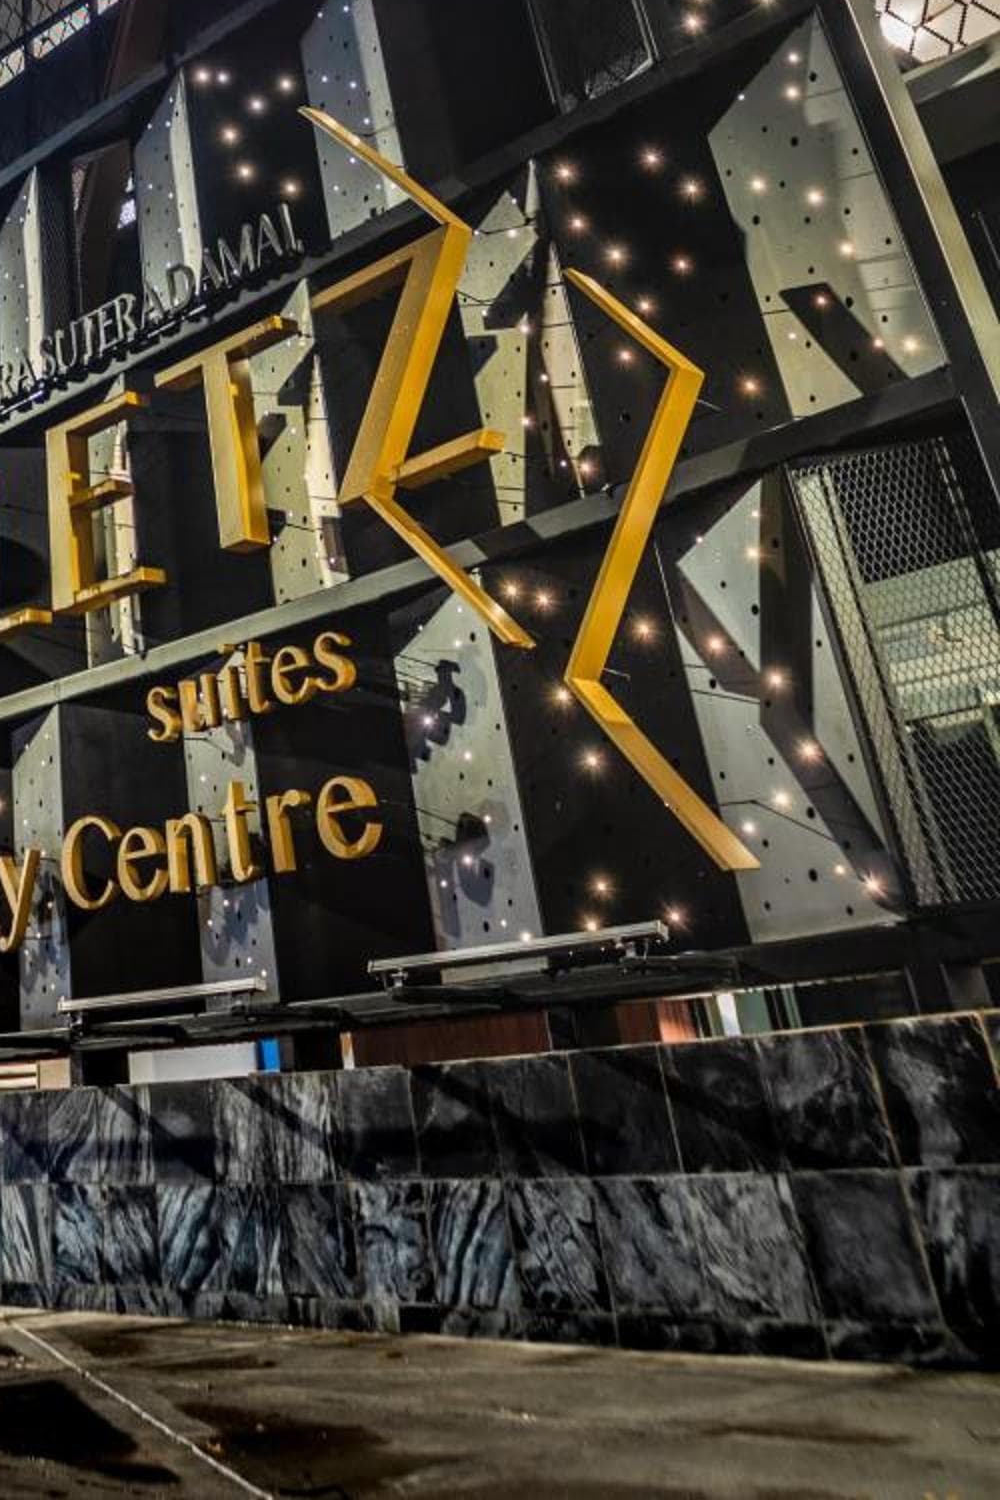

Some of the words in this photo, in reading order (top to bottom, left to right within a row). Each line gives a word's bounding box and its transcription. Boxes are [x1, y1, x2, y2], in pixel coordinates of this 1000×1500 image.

[41, 283, 166, 382] SUTERA
[167, 202, 299, 311] DAMAI
[146, 631, 358, 743] suites
[61, 775, 384, 911] Centre
